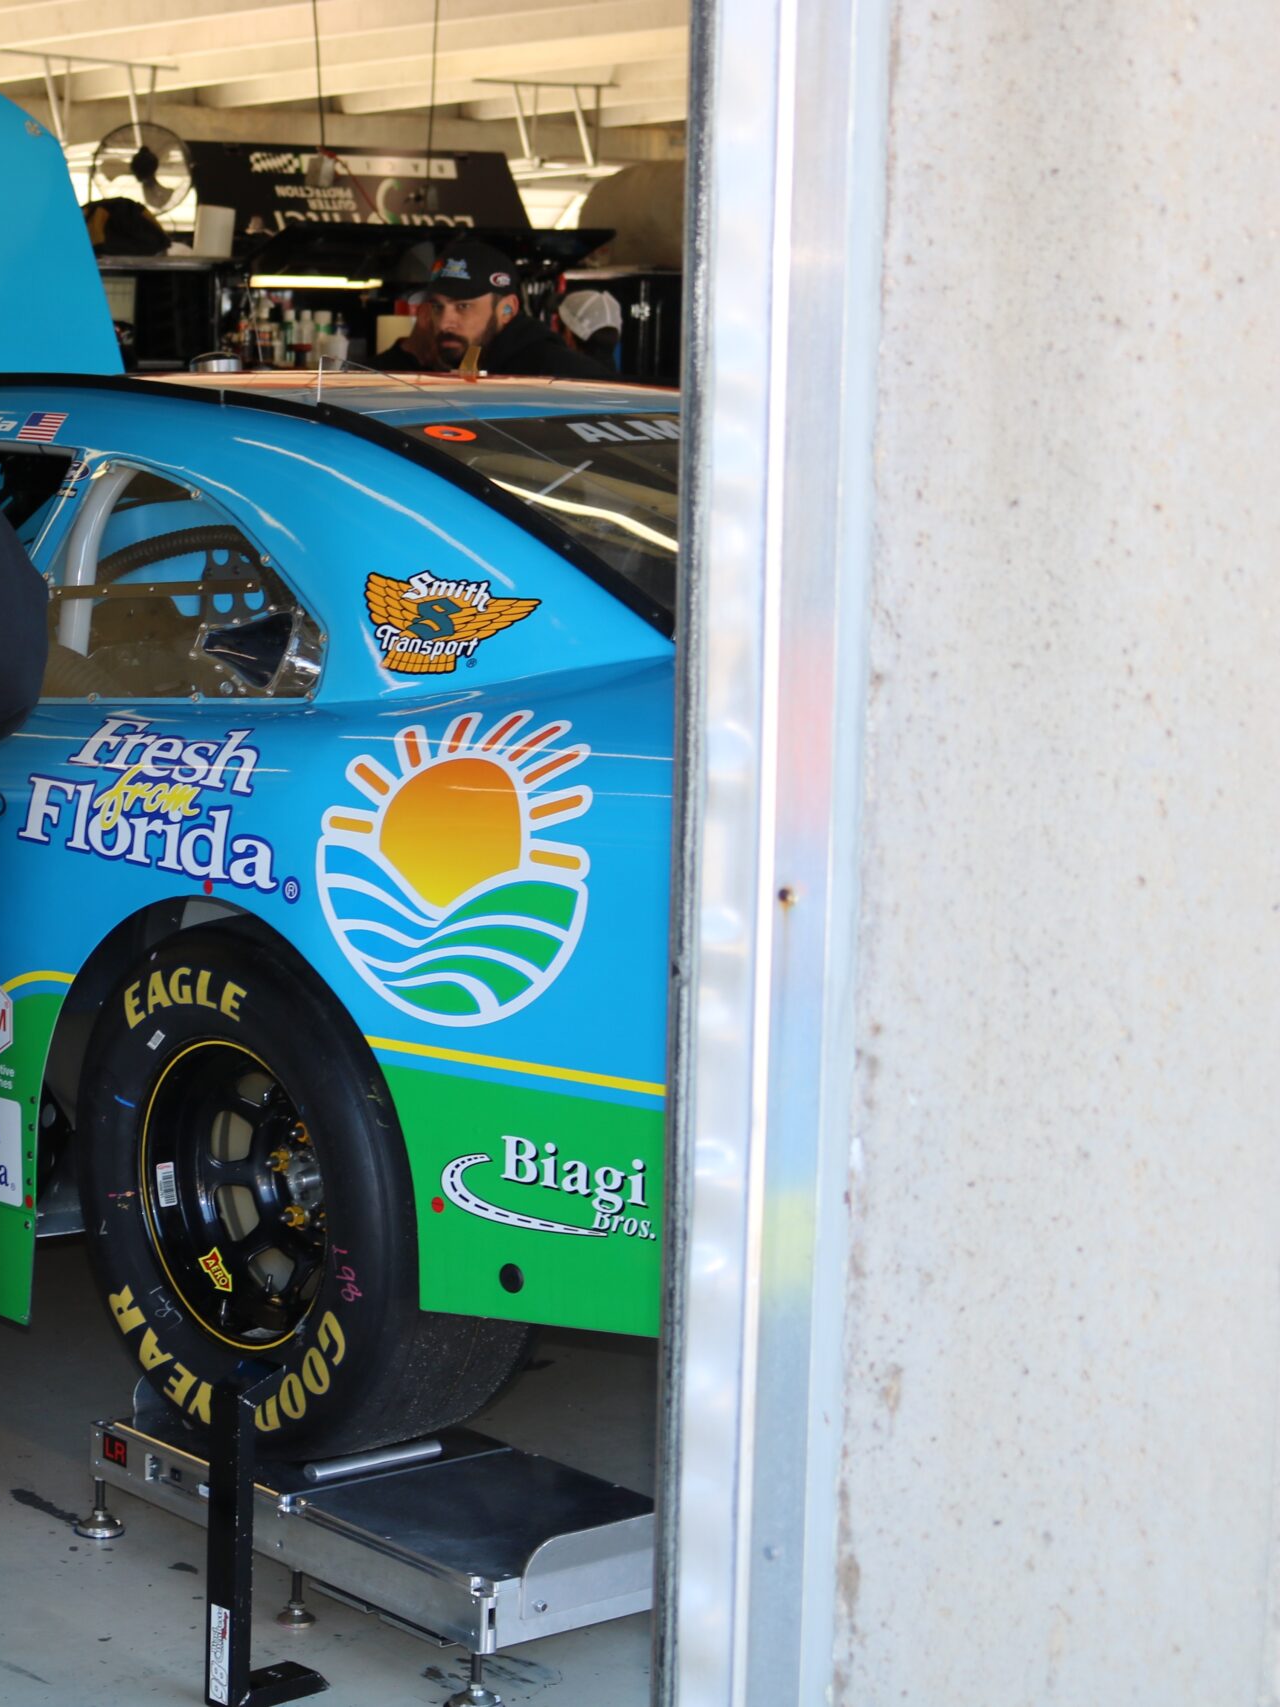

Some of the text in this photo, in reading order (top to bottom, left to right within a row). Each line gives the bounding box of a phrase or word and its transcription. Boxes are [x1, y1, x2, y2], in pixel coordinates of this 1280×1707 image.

[565, 419, 680, 443] ALM
[401, 571, 492, 613] Smith
[375, 624, 480, 661] Transport
[68, 718, 260, 796] Fresh
[95, 763, 202, 831] from
[18, 775, 279, 890] Florida
[124, 966, 248, 1029] EAGLE
[500, 1134, 648, 1214] Biagi
[591, 1212, 657, 1241] Bros.
[205, 1259, 228, 1286] AERO
[108, 1284, 347, 1433] YEAR GOOD
[104, 1437, 127, 1466] LR
